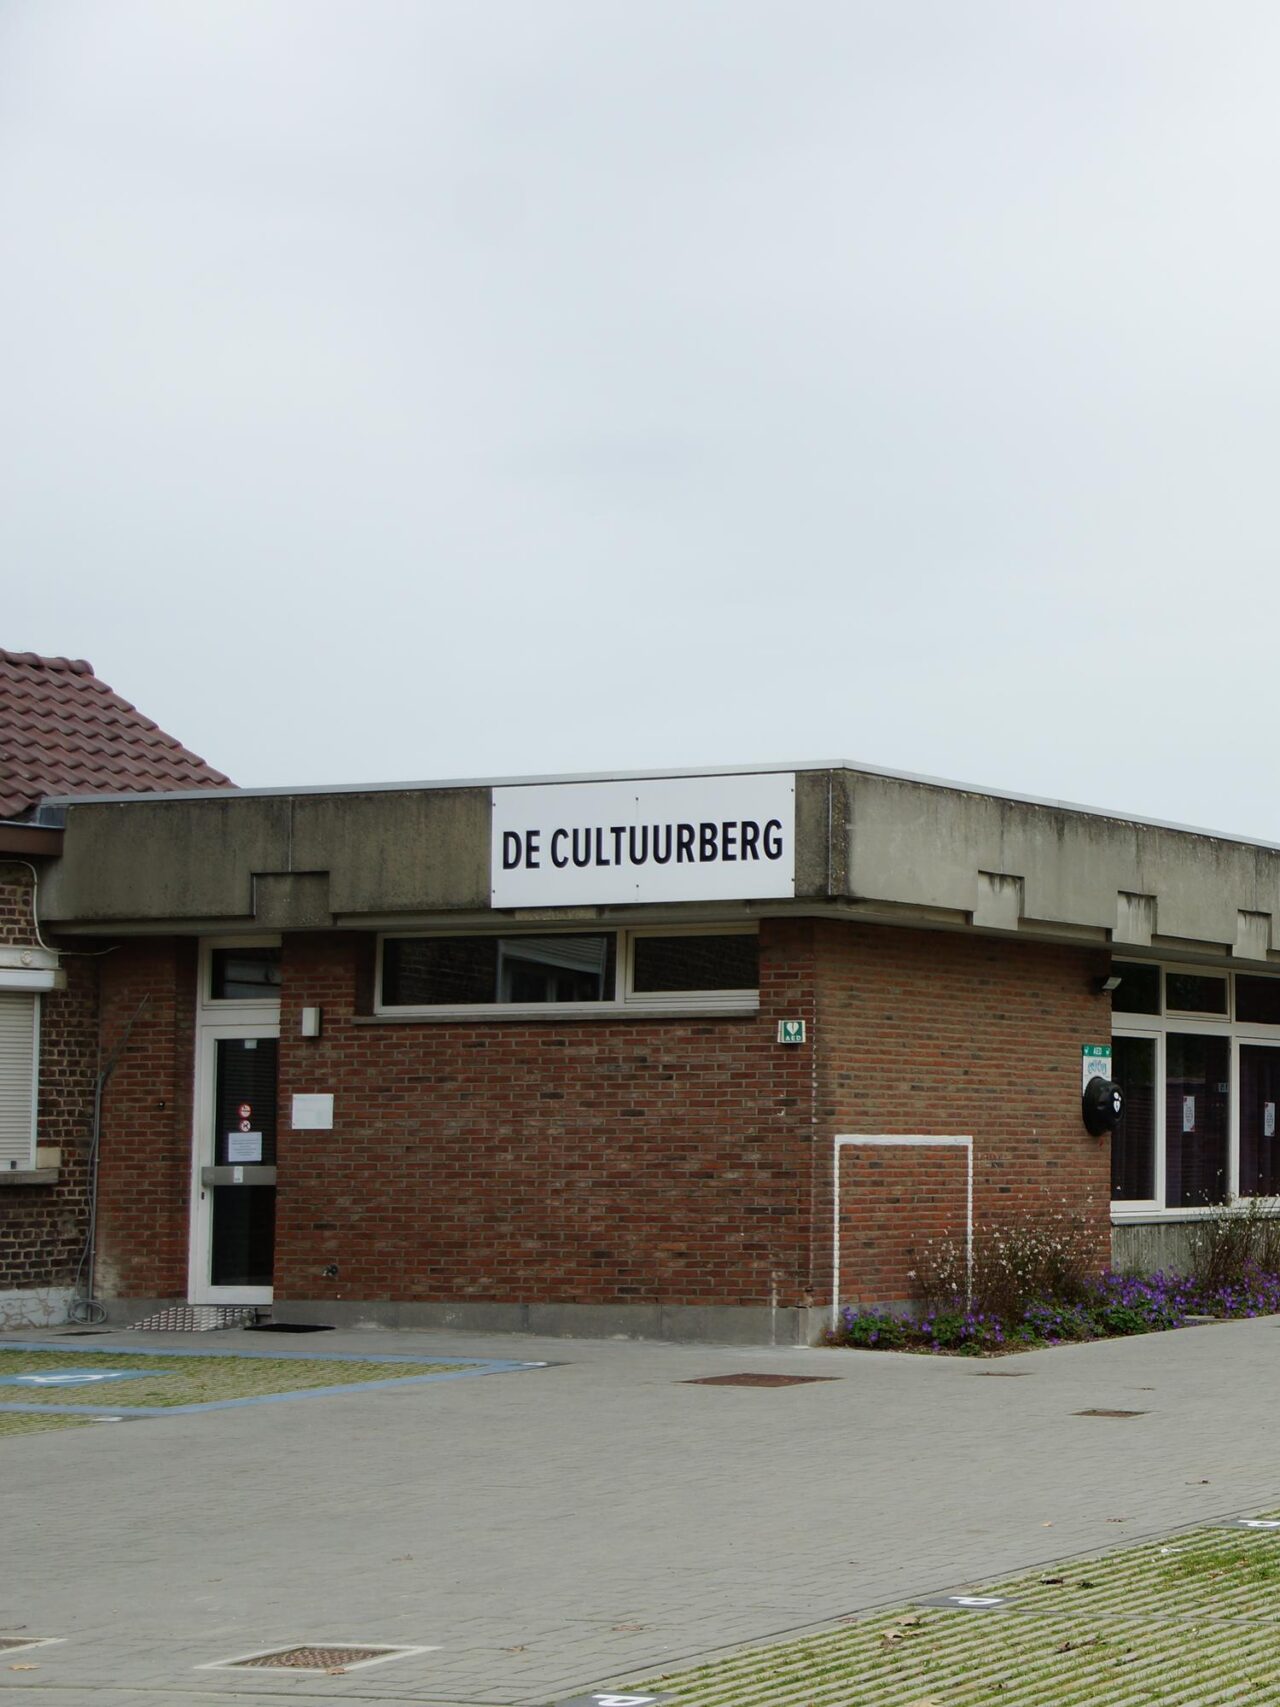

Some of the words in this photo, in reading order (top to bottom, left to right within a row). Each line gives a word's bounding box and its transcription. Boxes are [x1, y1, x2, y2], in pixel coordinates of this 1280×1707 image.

[502, 830, 541, 870] DE
[550, 819, 783, 868] CULTUURBERG
[592, 1694, 656, 1706] P
